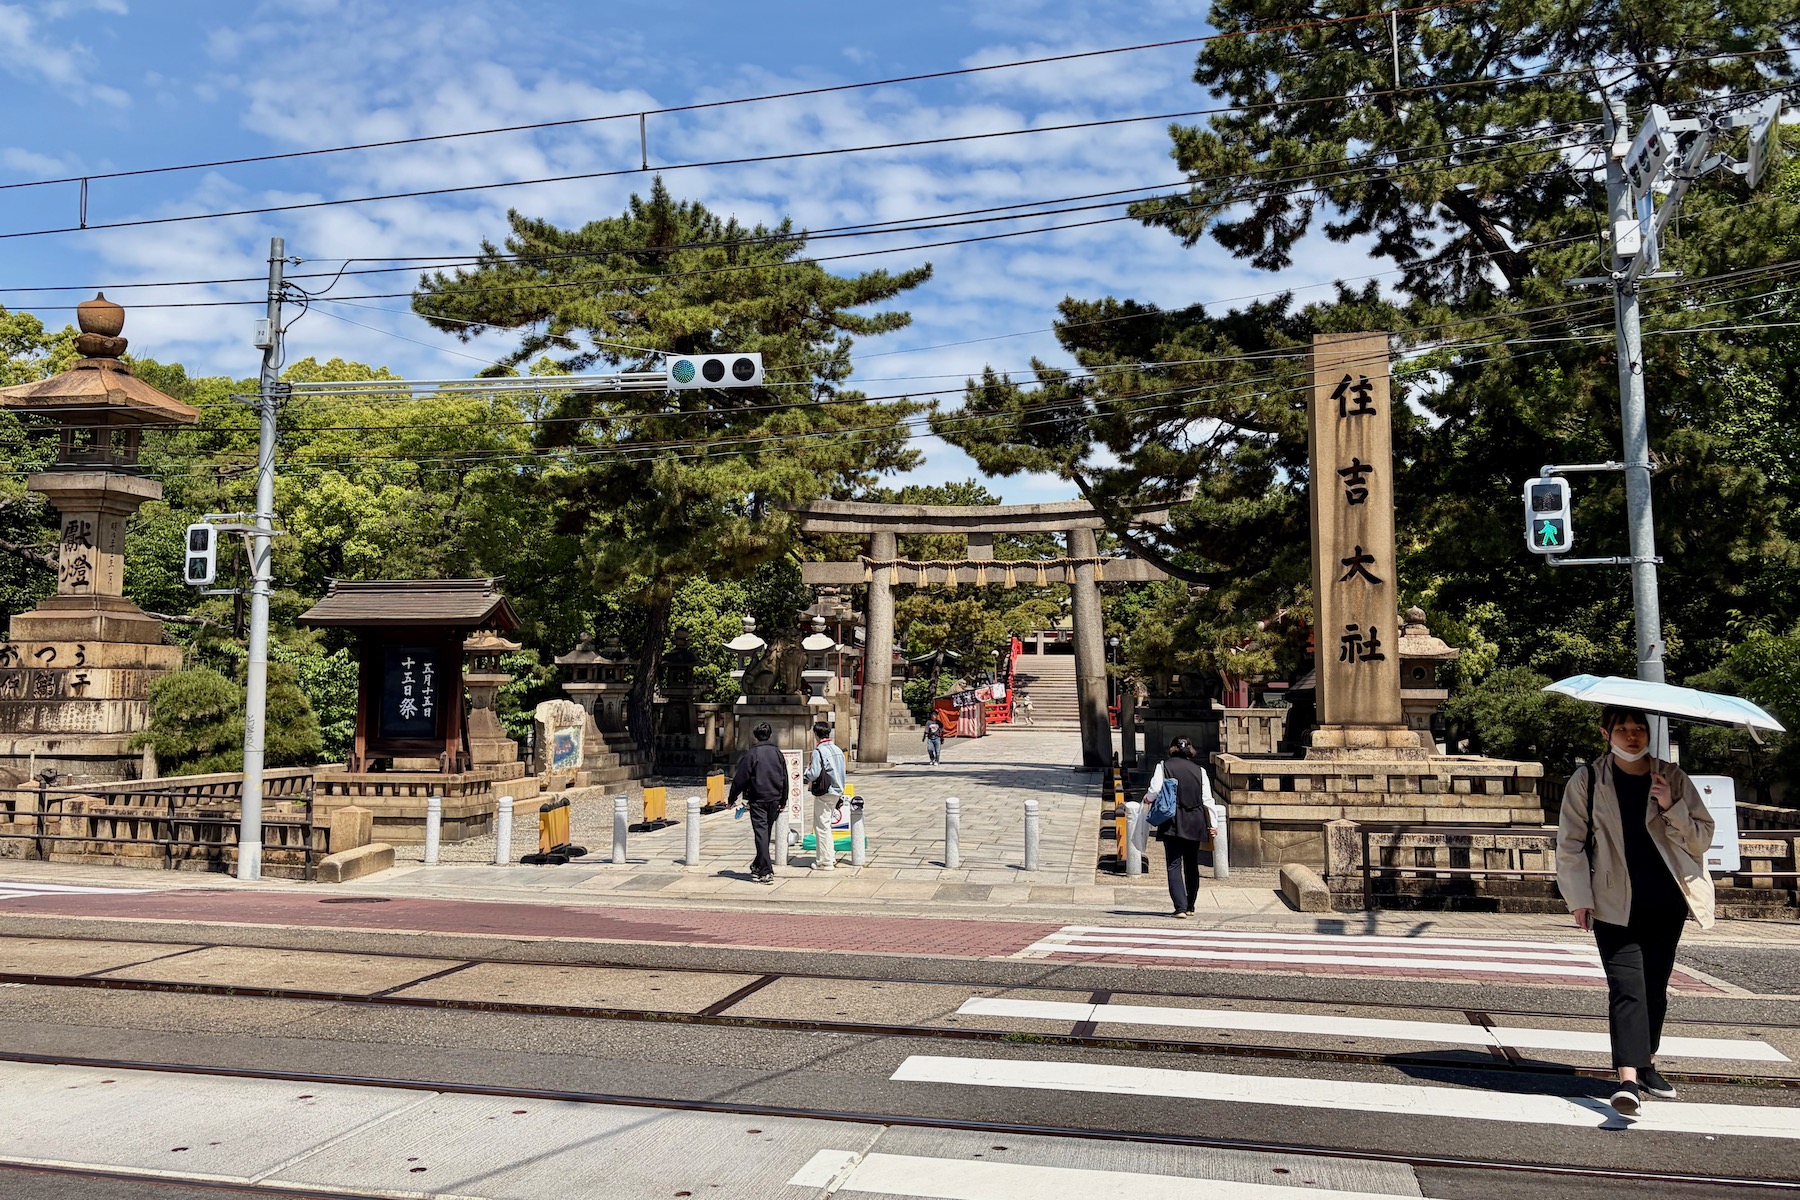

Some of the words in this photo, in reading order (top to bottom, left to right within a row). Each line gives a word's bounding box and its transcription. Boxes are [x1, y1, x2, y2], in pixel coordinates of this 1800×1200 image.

[1330, 373, 1386, 664] 住吉大社
[399, 657, 418, 719] 十五日祭
[422, 663, 434, 717] 五月十五日
